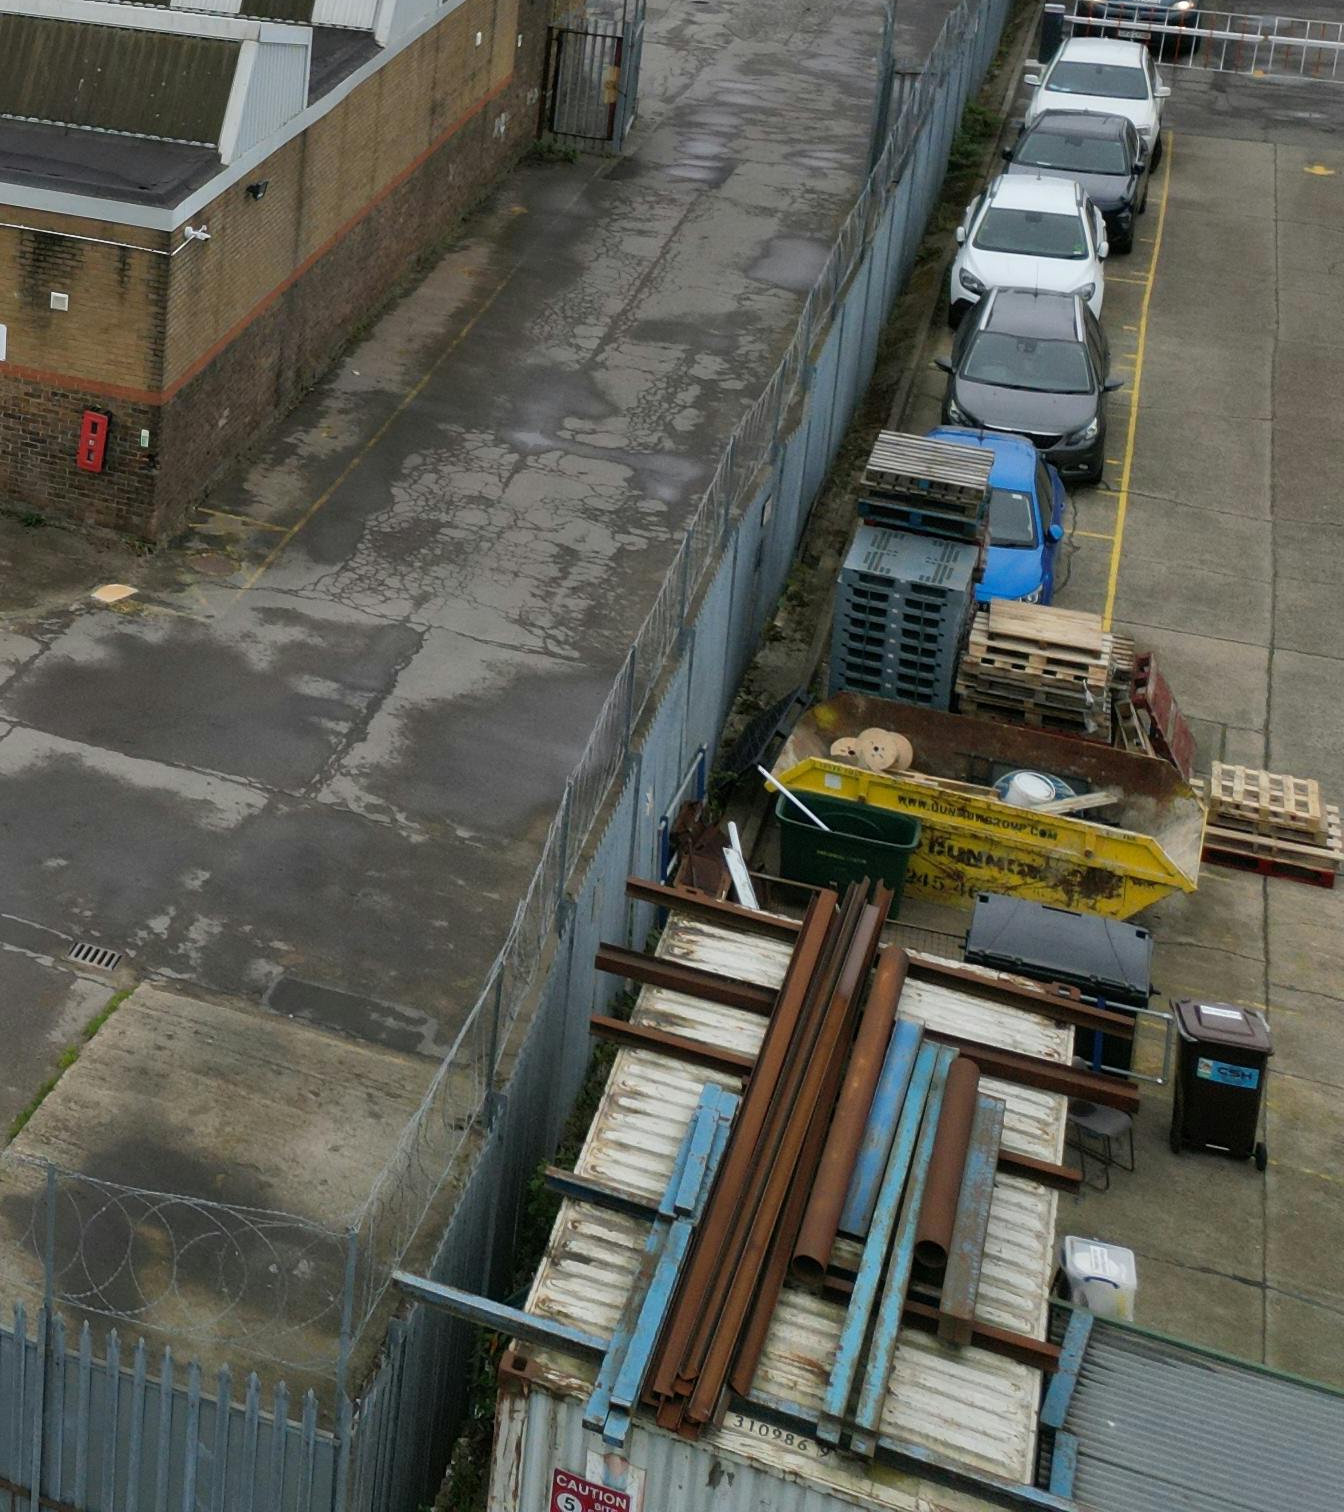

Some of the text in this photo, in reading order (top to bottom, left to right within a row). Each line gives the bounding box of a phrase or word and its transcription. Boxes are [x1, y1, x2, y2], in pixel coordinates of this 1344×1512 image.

[733, 1414, 809, 1451] 310986
[556, 1474, 627, 1510] CAUTION
[563, 1496, 575, 1511] 5
